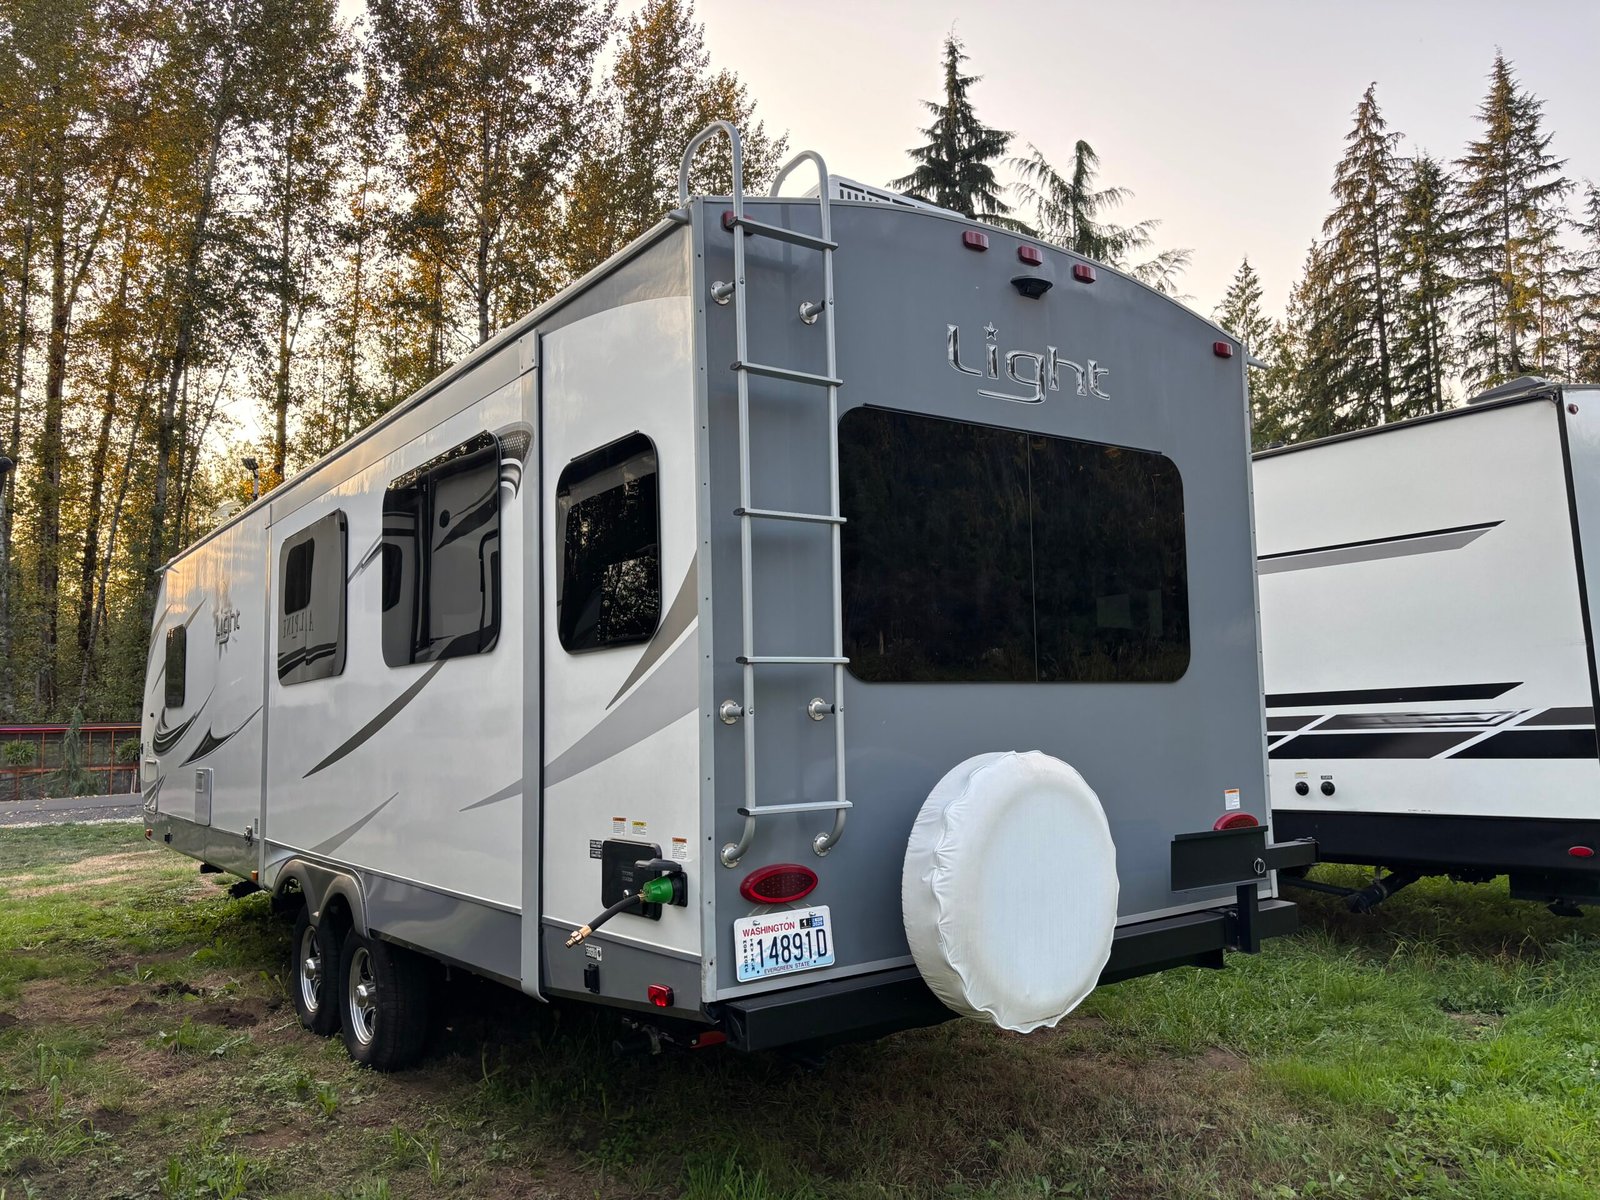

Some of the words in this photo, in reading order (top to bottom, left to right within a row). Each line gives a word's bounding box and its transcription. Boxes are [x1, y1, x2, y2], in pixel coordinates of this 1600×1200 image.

[947, 321, 1110, 404] Light
[215, 608, 241, 645] Light
[742, 921, 795, 937] WASHINGTON
[756, 928, 828, 968] 14891D
[764, 963, 793, 974] EVERGREEN
[795, 961, 810, 969] STATE
